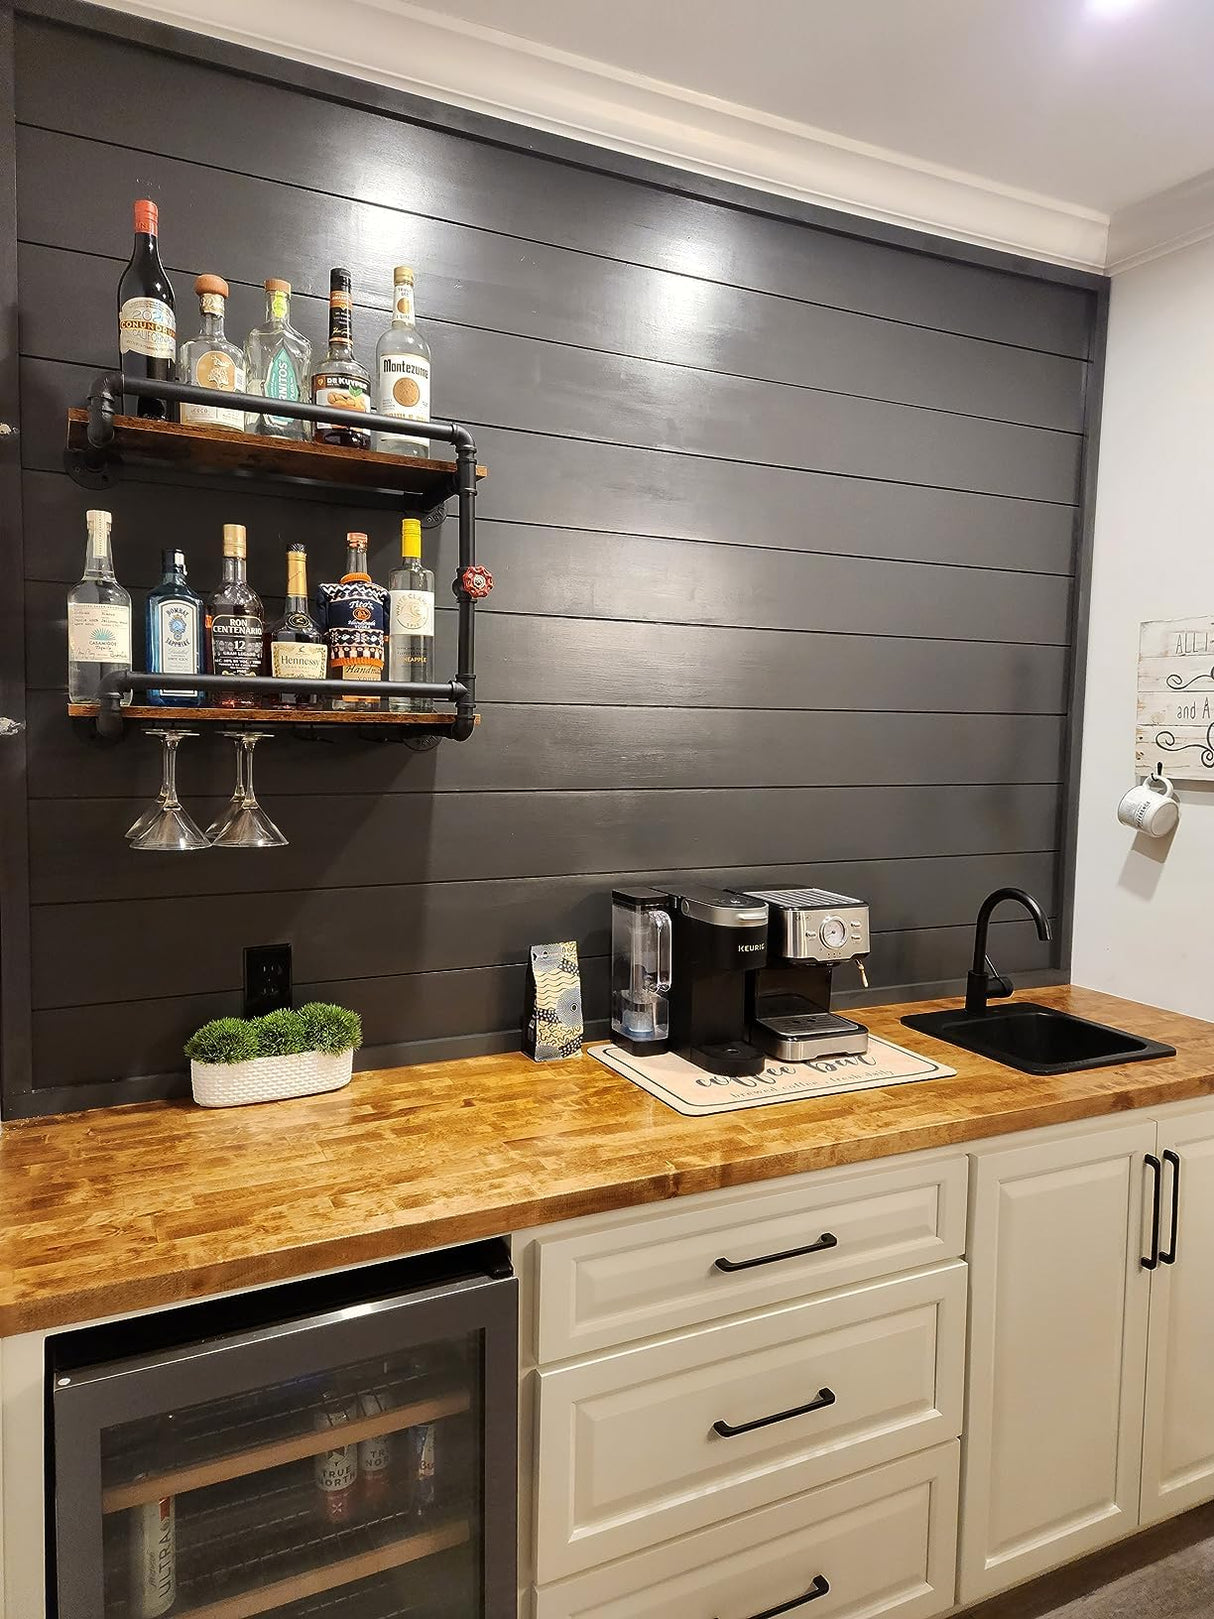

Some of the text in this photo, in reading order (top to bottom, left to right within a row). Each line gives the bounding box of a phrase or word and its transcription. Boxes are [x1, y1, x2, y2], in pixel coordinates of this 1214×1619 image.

[278, 359, 289, 400] RNITOS
[349, 600, 374, 611] Tito's
[229, 618, 249, 627] RON
[212, 625, 262, 636] CENTENARIO
[234, 640, 246, 651] 12
[1175, 632, 1200, 655] ALL
[1176, 700, 1197, 720] and
[738, 942, 766, 953] KEURIG
[159, 1527, 172, 1599] ULTRA
